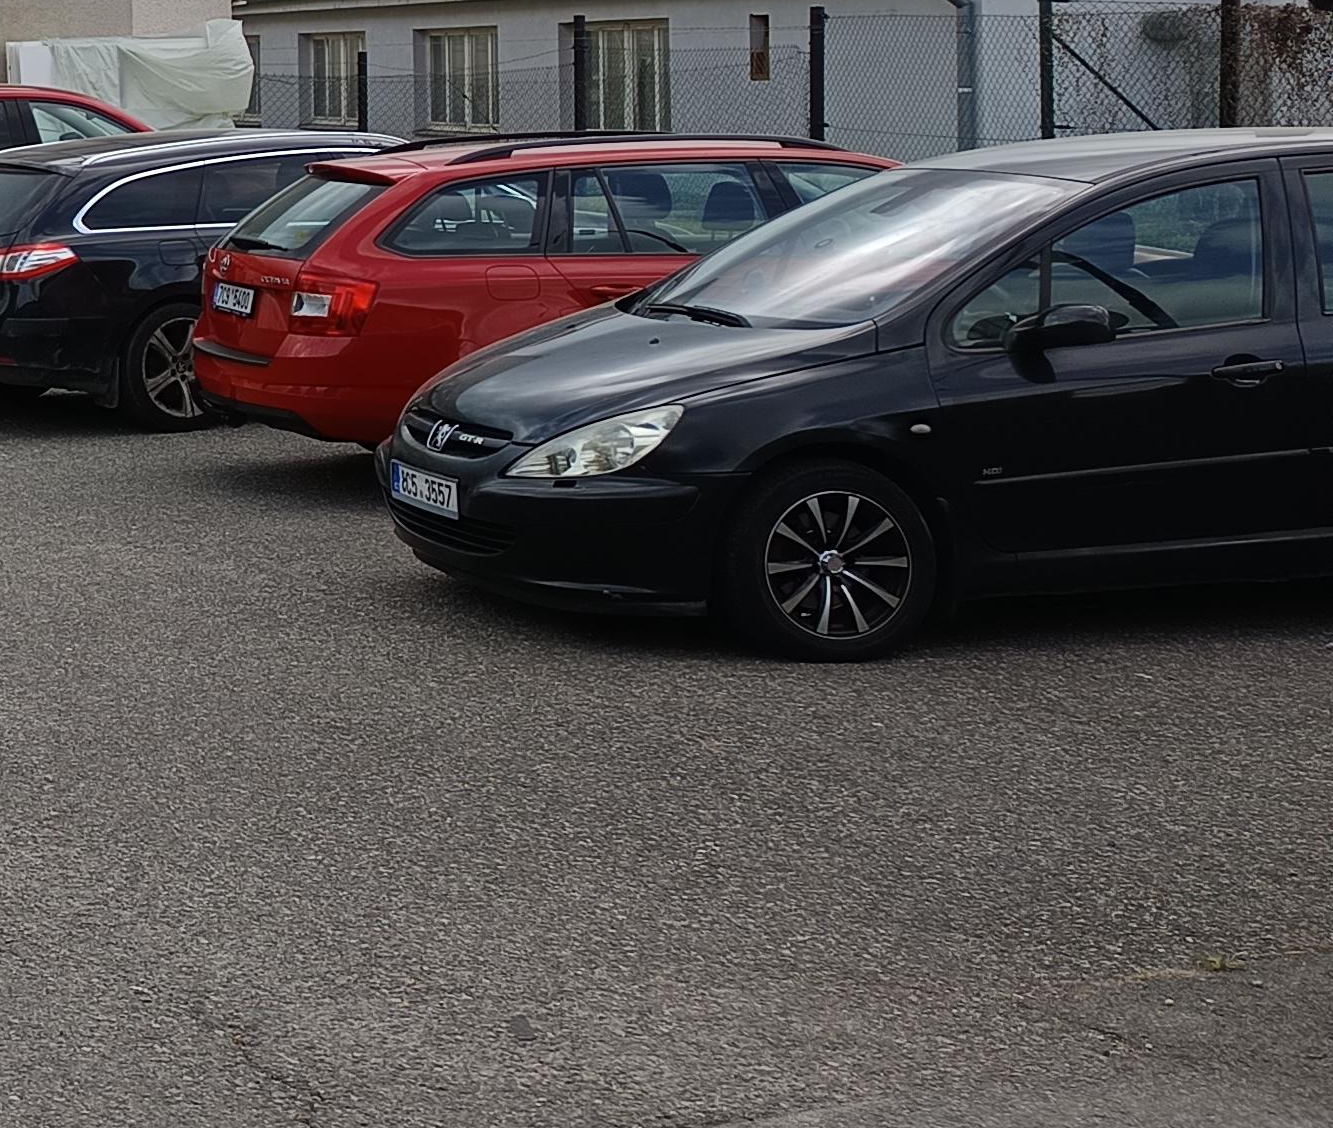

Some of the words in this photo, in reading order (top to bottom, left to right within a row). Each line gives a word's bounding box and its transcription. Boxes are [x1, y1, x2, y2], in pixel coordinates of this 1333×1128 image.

[232, 288, 251, 310] 5400
[458, 433, 485, 445] GT-R
[401, 469, 418, 498] 8C5
[424, 478, 452, 508] 3557
